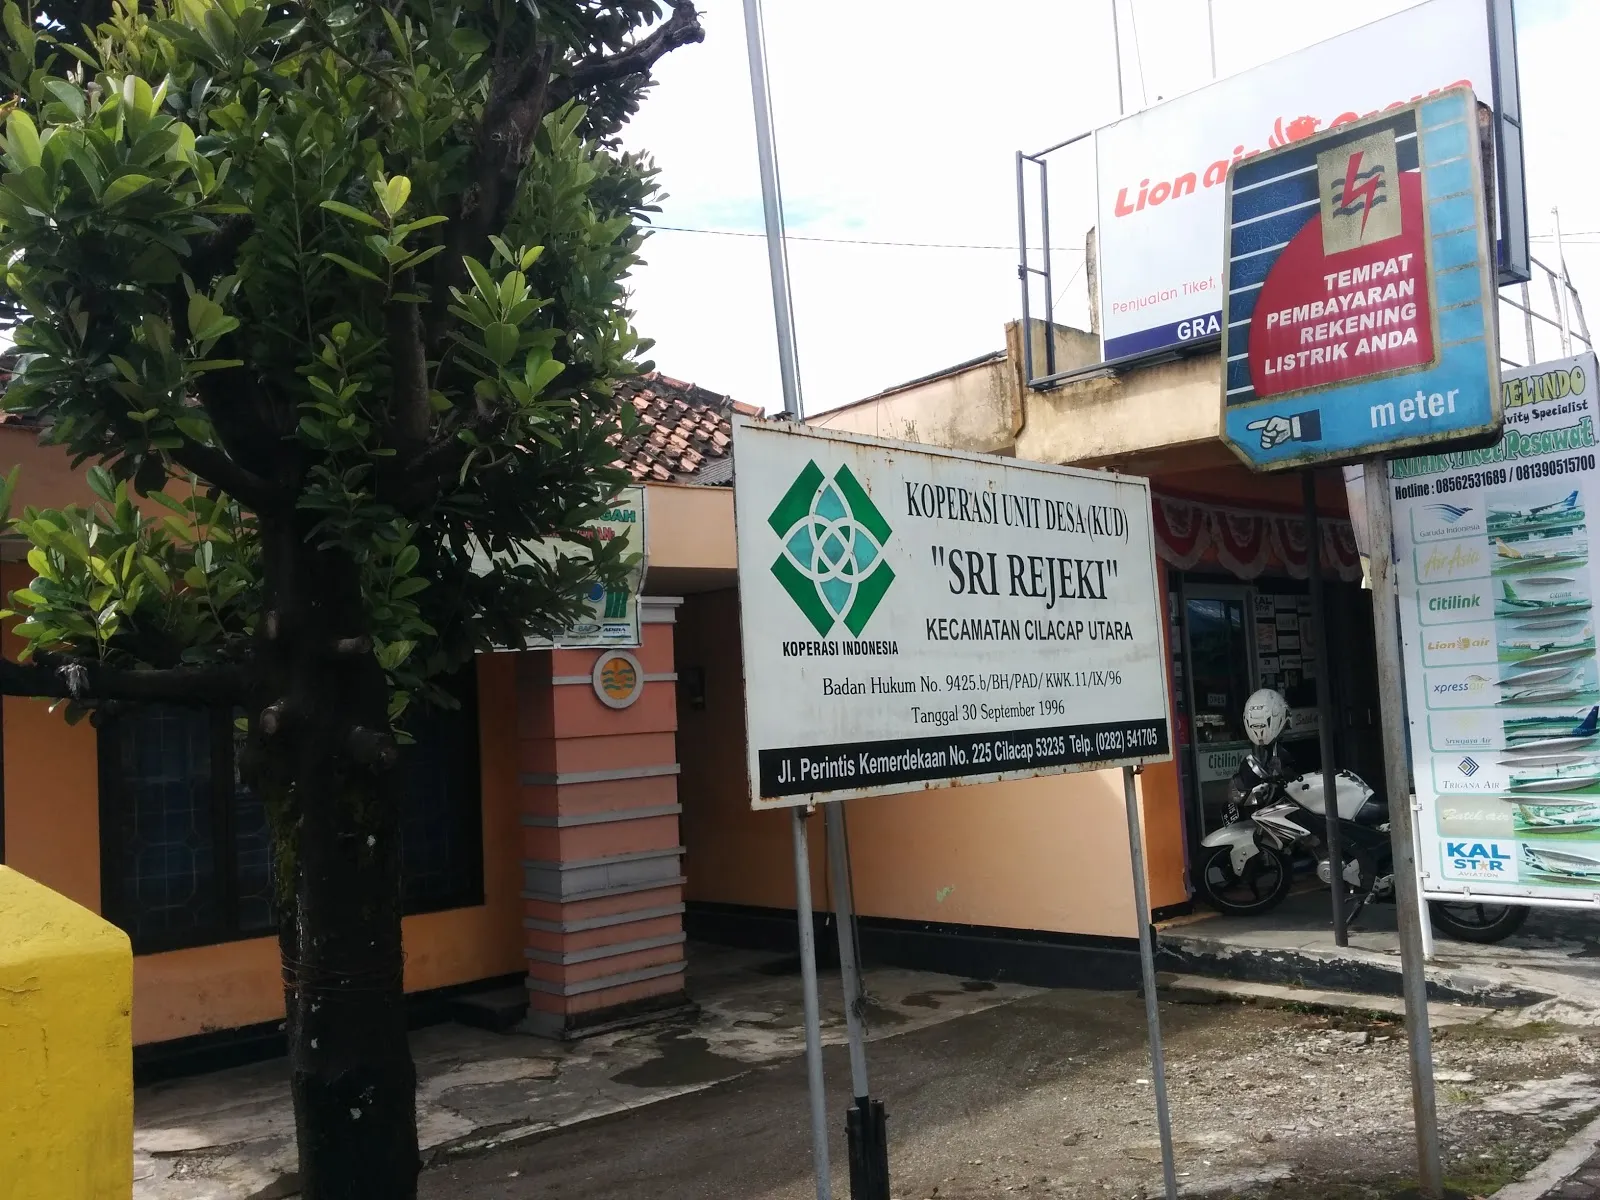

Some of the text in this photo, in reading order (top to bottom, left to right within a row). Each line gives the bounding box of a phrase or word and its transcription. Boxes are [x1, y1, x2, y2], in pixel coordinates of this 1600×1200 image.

[1114, 178, 1197, 218] Lion
[1323, 253, 1413, 291] TEMPAT
[1112, 288, 1178, 315] Penjualan
[1182, 276, 1216, 295] Tiket,
[1266, 279, 1415, 330] PEMBAYARAN
[1299, 303, 1417, 345] REKENING
[1264, 328, 1418, 375] LISTRIK ANDA
[1370, 388, 1460, 428] meter
[1531, 399, 1589, 421] Specialist
[1504, 415, 1596, 461] Pesawat
[1394, 481, 1430, 500] Hotline
[1435, 469, 1507, 494] 08562531689
[1515, 454, 1596, 481] 081390515700
[905, 481, 999, 525] KOPERASI
[1001, 493, 1041, 529] UNIT
[1420, 525, 1481, 538] Garuda Indonesia
[931, 545, 1119, 609] "SRI REJEKI"
[1428, 594, 1481, 611] Citilink
[782, 639, 899, 657] KOPERASI INDONESIA
[926, 618, 1133, 641] KECAMATAN CILACAP UTARA
[1427, 638, 1490, 651] Lion air
[823, 676, 867, 696] Badan
[870, 675, 916, 694] Hukum
[920, 675, 942, 693] No.
[911, 700, 1065, 727] Tanggal 30 September 1996
[777, 727, 1158, 784] Jl. Perintis Kemerdekaan No. 225 Cilacap 53235 Telp. (0282) 541705
[1447, 842, 1511, 859] KAL
